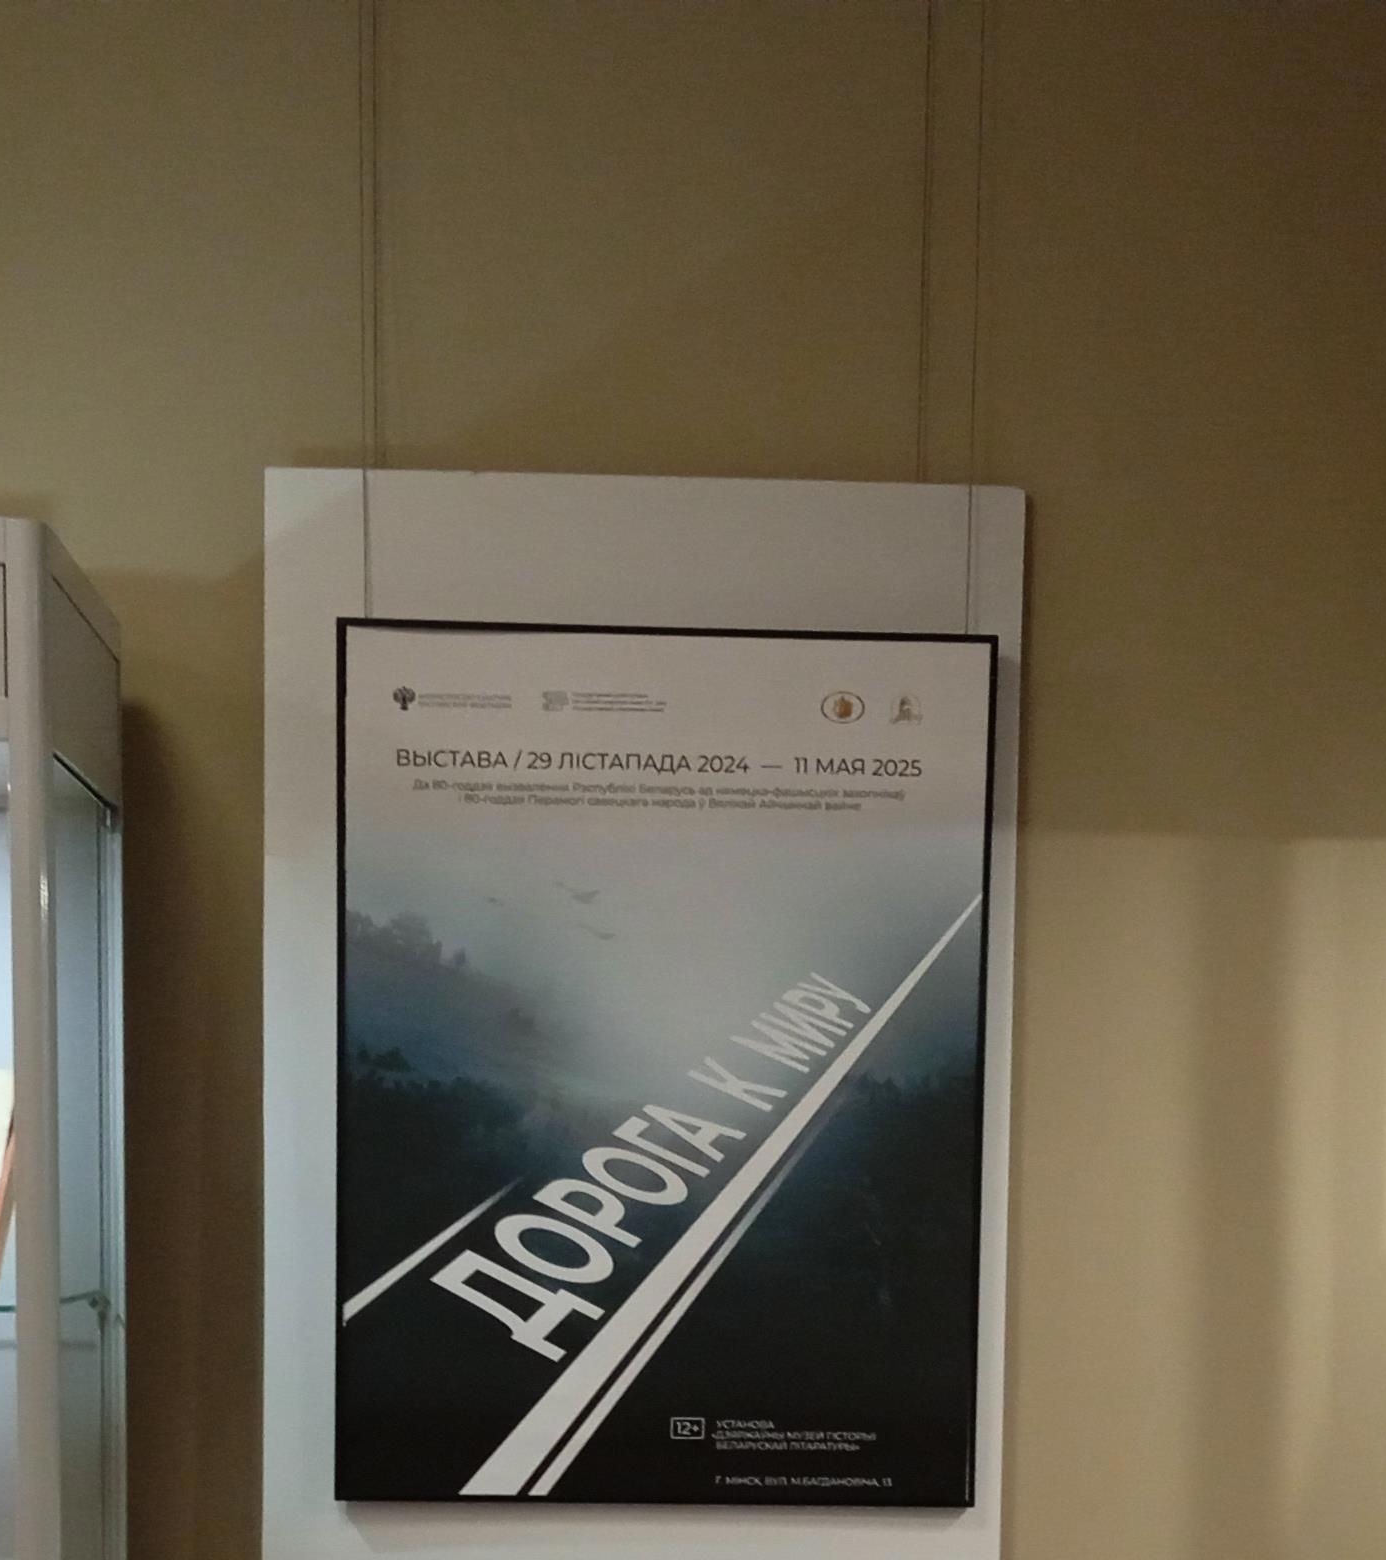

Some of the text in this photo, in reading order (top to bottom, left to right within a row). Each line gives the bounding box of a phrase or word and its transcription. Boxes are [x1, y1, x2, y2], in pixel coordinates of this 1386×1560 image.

[396, 749, 509, 769] ВЫСТАВА
[514, 749, 523, 771] /
[527, 752, 552, 770] 29
[558, 752, 691, 774] ЛІСТАПАДА
[697, 755, 750, 773] 2024
[794, 757, 808, 774] 11
[815, 757, 866, 775] МАЯ
[872, 759, 923, 777] 2025
[429, 971, 872, 1363] ДОРОГА К МИРУ
[676, 1421, 700, 1436] 12+
